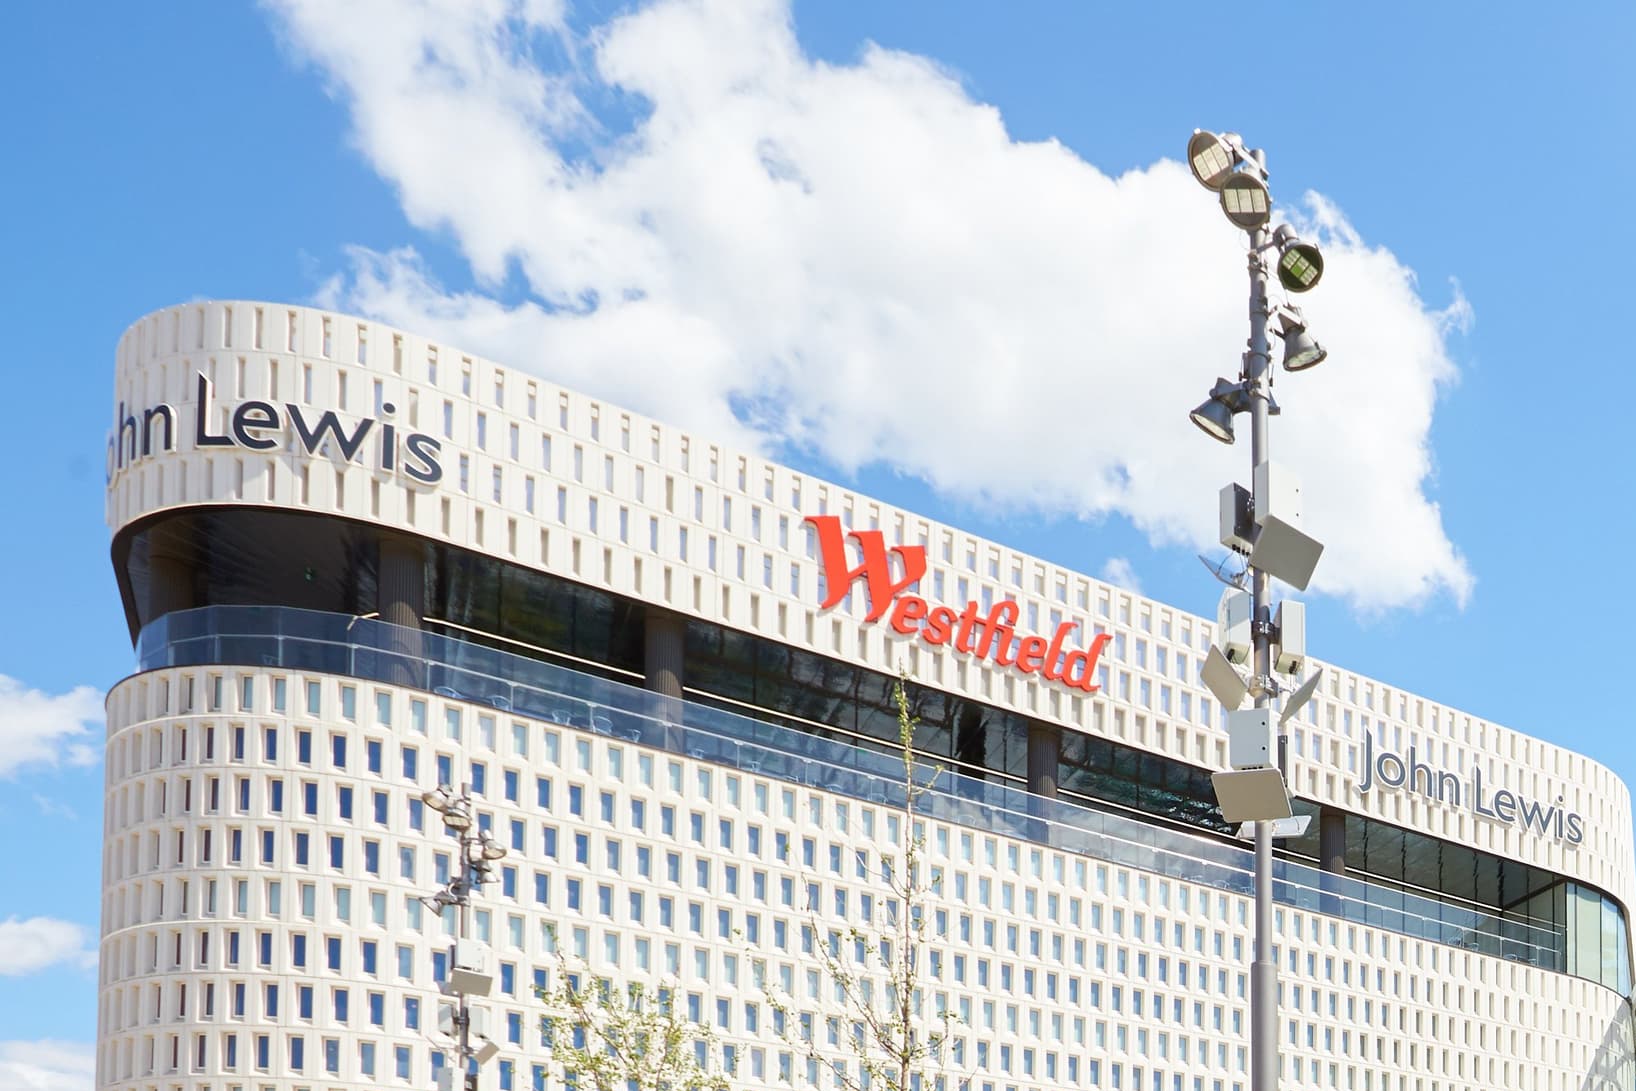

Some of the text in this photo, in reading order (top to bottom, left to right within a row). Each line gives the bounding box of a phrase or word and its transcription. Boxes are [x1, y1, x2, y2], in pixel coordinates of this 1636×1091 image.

[106, 370, 442, 487] ohn Lewis
[804, 516, 1113, 692] Westfield
[1359, 728, 1583, 844] John Lewis
